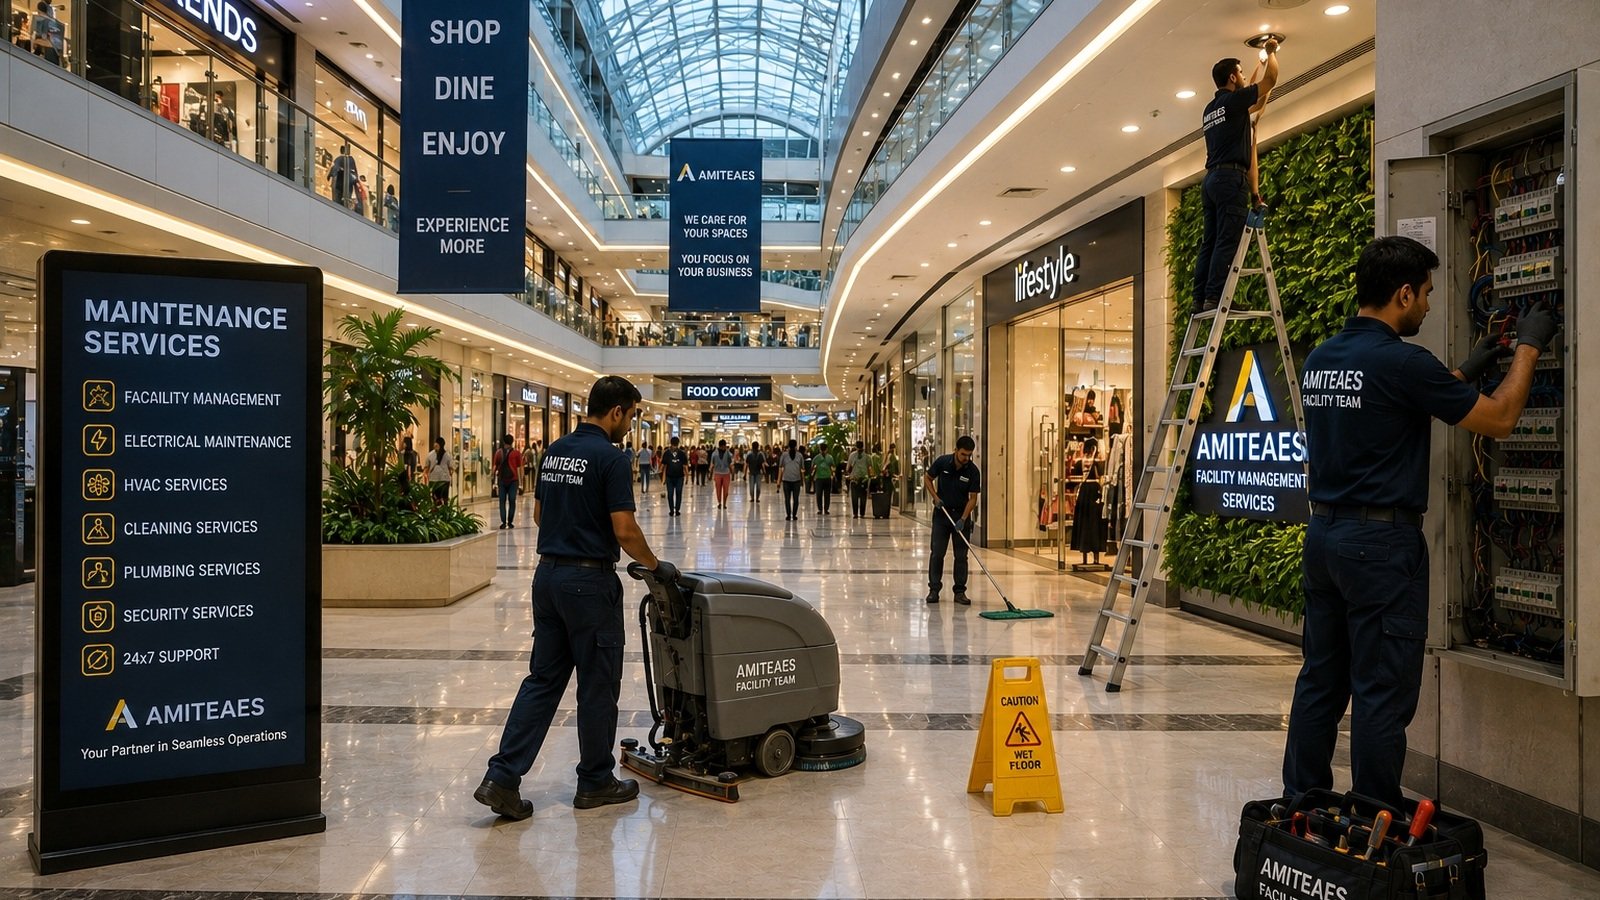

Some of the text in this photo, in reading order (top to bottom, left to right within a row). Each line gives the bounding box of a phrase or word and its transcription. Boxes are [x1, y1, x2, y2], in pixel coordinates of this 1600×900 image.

[177, 0, 257, 53] NDS
[430, 19, 501, 45] SHOP
[435, 76, 494, 100] DINE
[422, 131, 506, 156] ENJOY
[698, 170, 755, 181] AMITEAES
[416, 217, 510, 233] EXPERIENCE
[684, 215, 747, 225] WE CARE FOR
[683, 228, 748, 238] YOUR SPACES
[440, 238, 485, 254] MORE
[681, 254, 750, 264] YOU FOCUS ON
[678, 267, 753, 277] YOUR BUSINESS
[1015, 245, 1075, 303] lifestyle
[85, 299, 287, 330] MAINTENANCE
[84, 330, 221, 357] SERVICES
[1302, 370, 1364, 391] AMITEAES
[124, 390, 282, 406] FACAILITY MANAGEMENT
[687, 386, 761, 397] FOOD COURT
[1335, 395, 1361, 409] TEAM
[124, 434, 291, 449] ELECTRICAL MAINTENANCE
[1196, 431, 1307, 462] AMITEAES
[541, 455, 588, 473] AMITEAES
[124, 478, 228, 492] HVAC SERVICES
[1196, 469, 1307, 488] FACILITY MANAGEMENT
[1222, 492, 1275, 512] SERVICES
[124, 520, 258, 536] CLEANING SERVICES
[124, 562, 261, 579] PLUMBING SERVICES
[123, 604, 254, 622] SECURITY SERVICES
[123, 647, 220, 666] 24x7 SUPPORT
[736, 658, 796, 678] AMITEAES
[736, 675, 796, 692] FACILITY TEAM
[1001, 696, 1039, 706] CAUTION
[146, 697, 265, 726] AMITEAES
[81, 730, 287, 760] Your Partner in Seamless Operations
[1014, 750, 1034, 759] WET
[1009, 760, 1041, 770] FLOOR
[1260, 858, 1348, 900] AMITEAES
